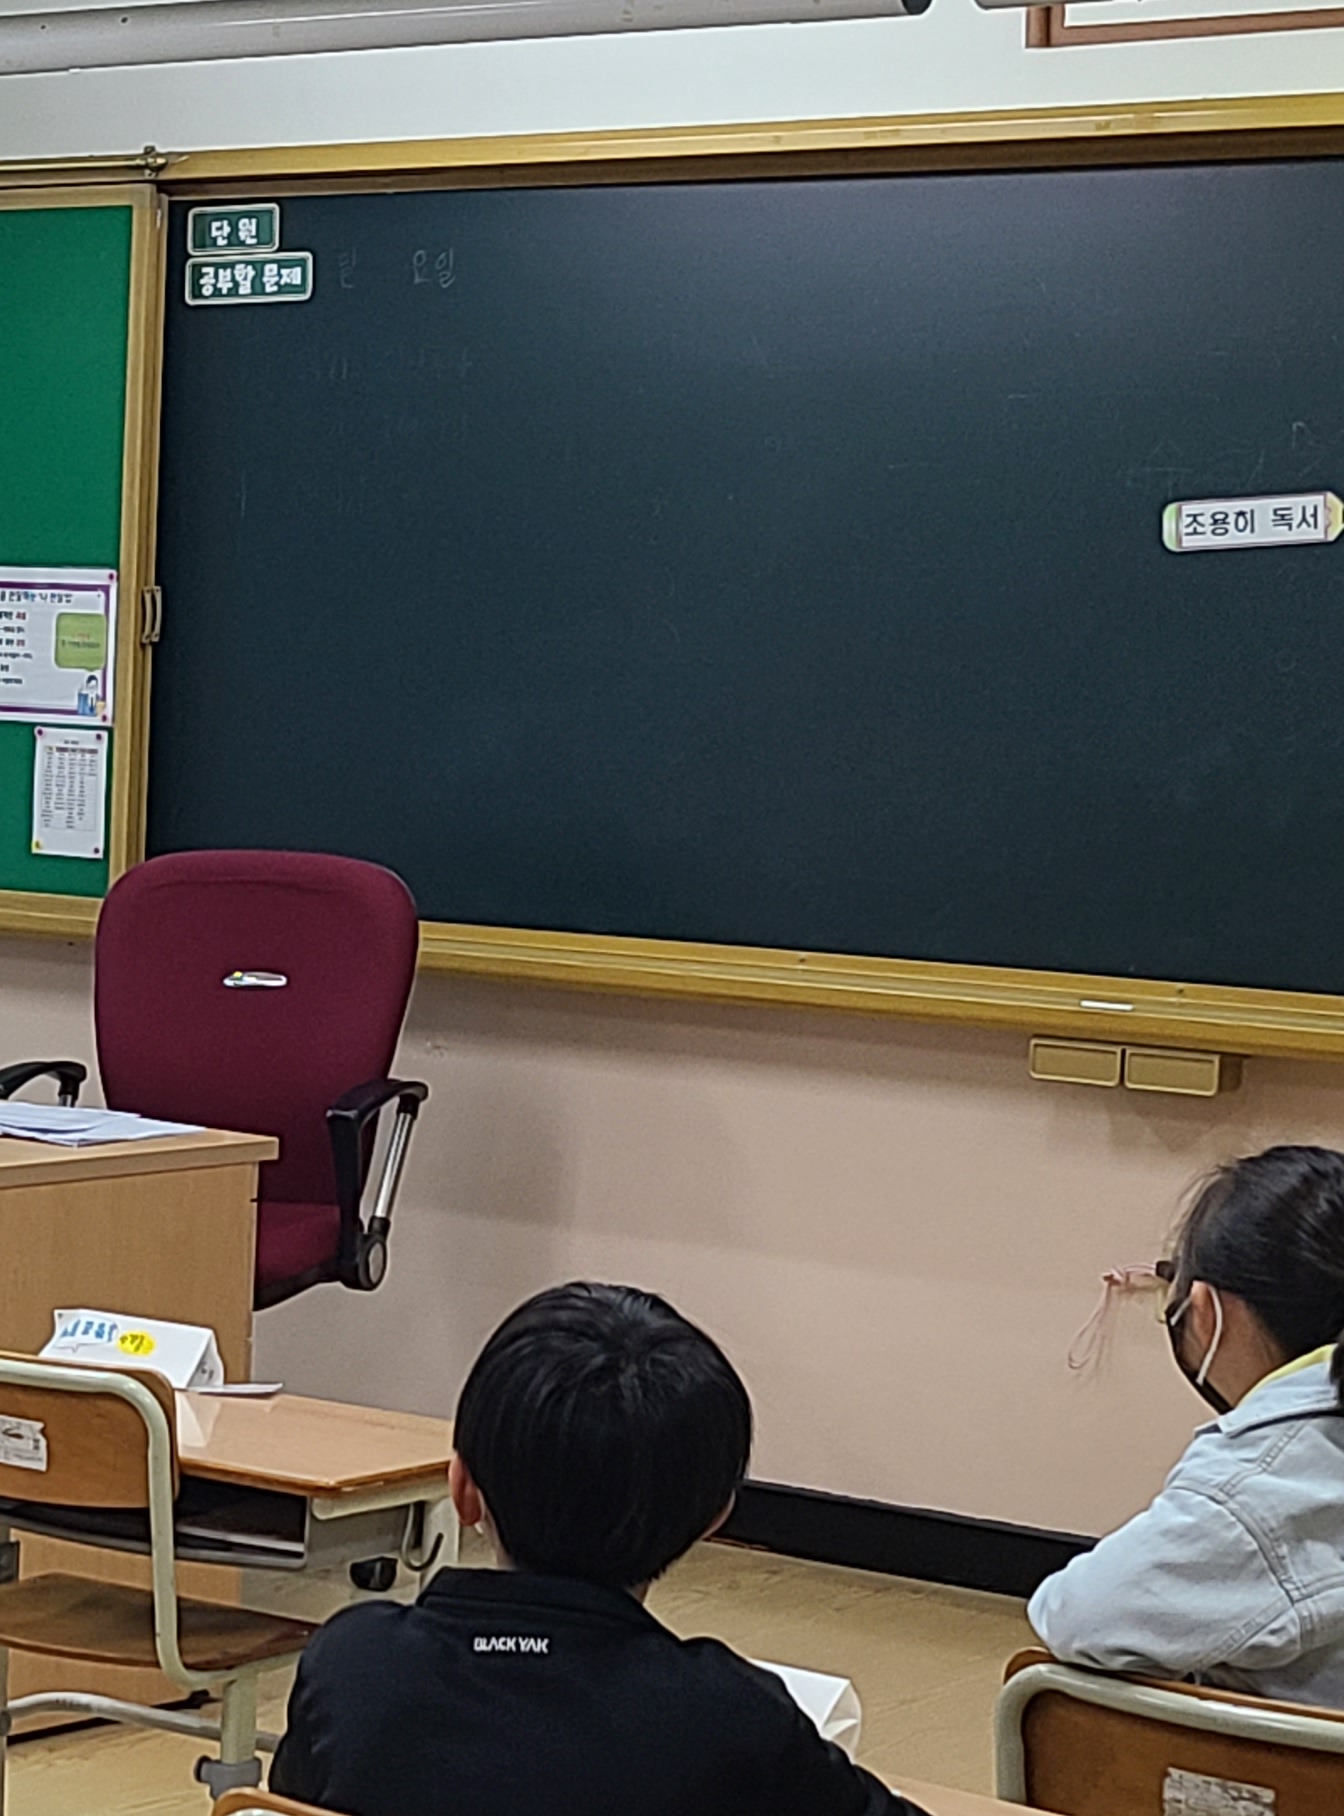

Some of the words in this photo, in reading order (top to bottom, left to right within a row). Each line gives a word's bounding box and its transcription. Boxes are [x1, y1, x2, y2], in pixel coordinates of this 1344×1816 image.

[199, 263, 256, 297] 공부할
[262, 263, 302, 294] 문제
[1183, 507, 1256, 537] 조용히
[1271, 503, 1319, 532] 독서
[473, 1636, 517, 1653] BLACK
[518, 1636, 549, 1654] YAK
